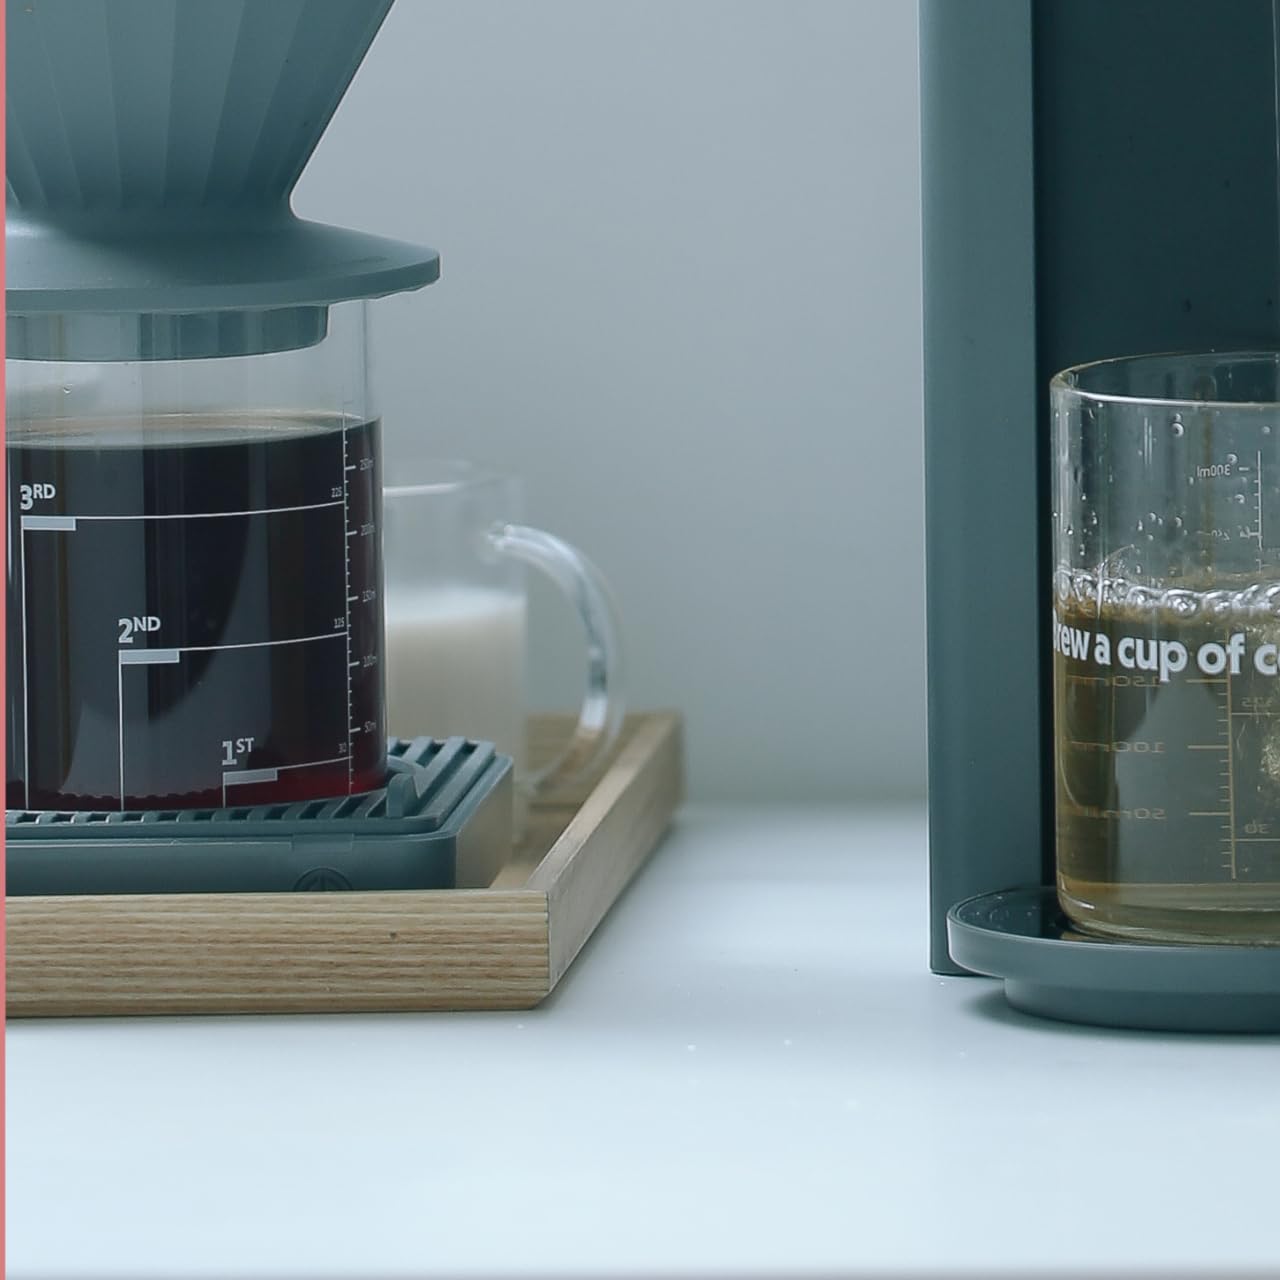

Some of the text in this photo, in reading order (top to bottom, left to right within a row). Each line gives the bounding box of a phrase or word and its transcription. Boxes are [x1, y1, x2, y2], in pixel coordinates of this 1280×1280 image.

[20, 484, 56, 510] 3RD
[118, 616, 161, 643] 2ND
[1094, 632, 1111, 666] a
[1117, 637, 1188, 683] cup
[1197, 632, 1245, 675] of
[222, 737, 254, 765] 1ST
